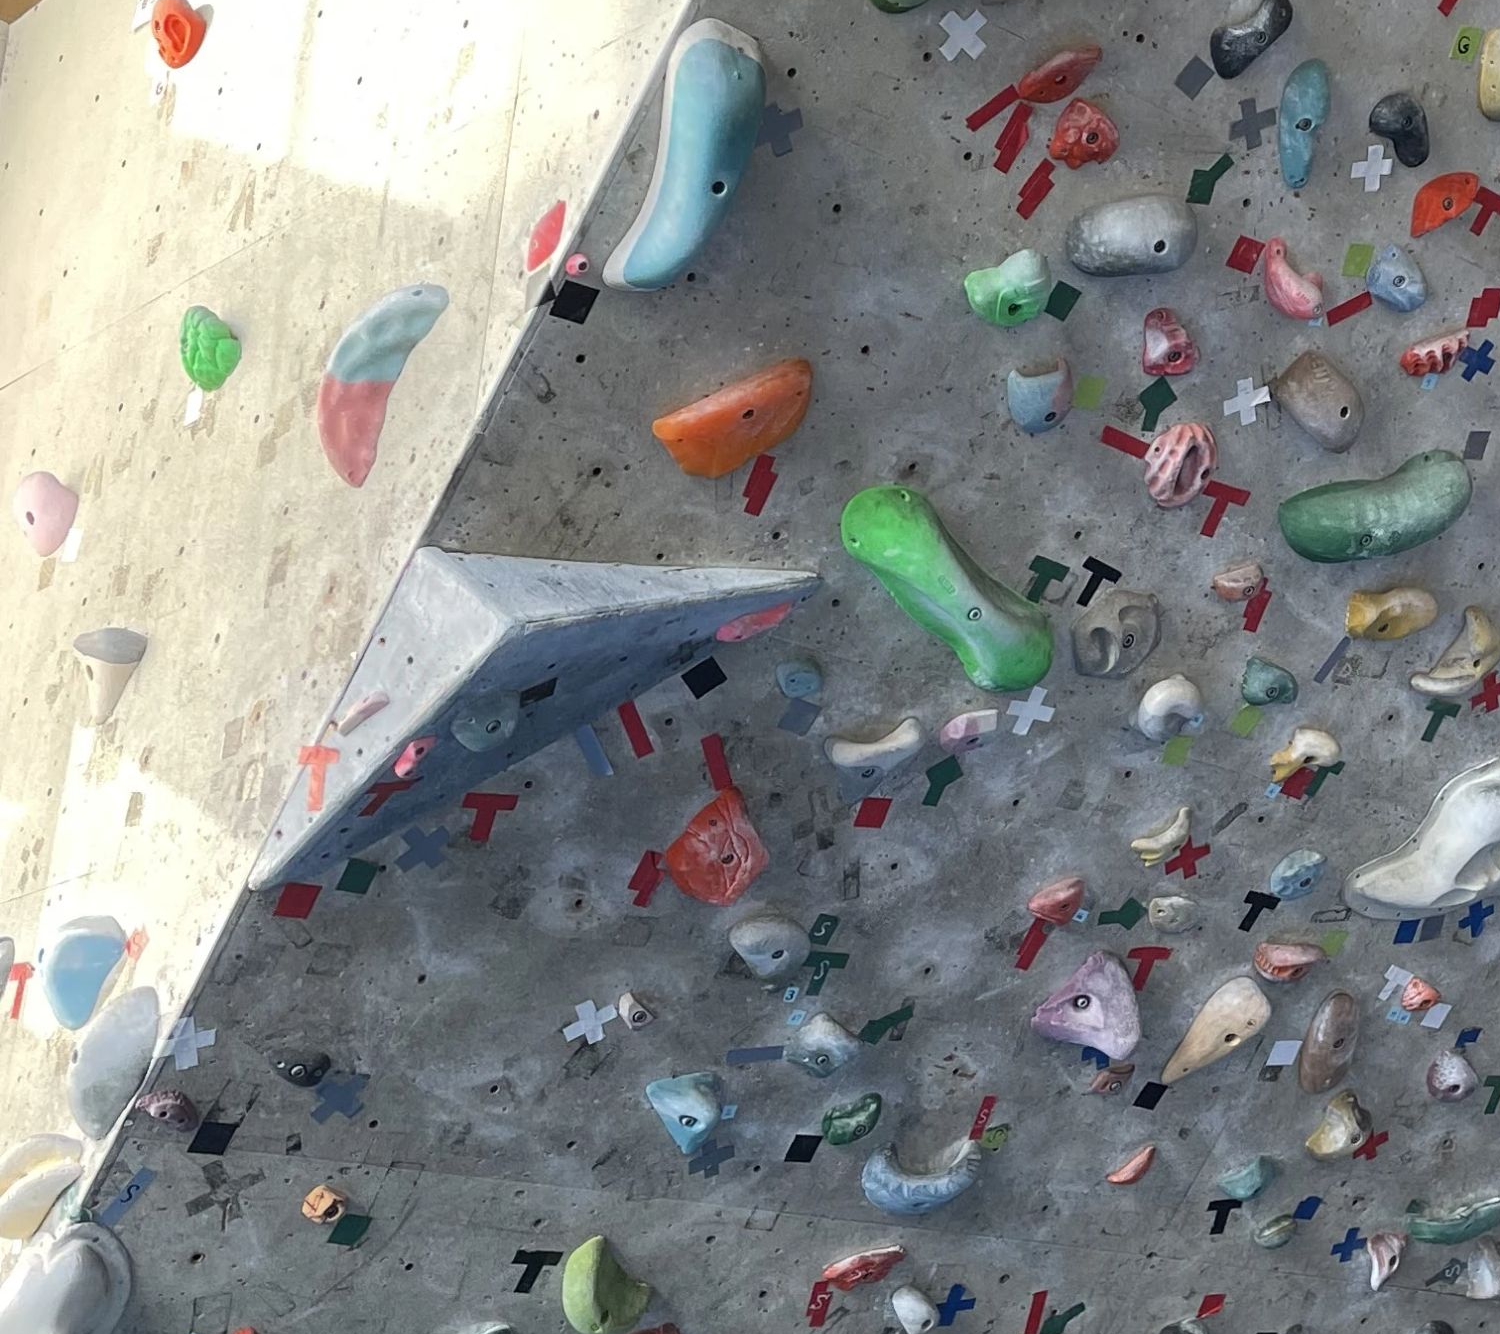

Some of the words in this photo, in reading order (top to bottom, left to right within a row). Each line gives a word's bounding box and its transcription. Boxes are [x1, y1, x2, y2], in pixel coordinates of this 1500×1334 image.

[1457, 35, 1472, 55] G
[814, 921, 831, 937] S
[813, 959, 830, 980] S
[785, 989, 795, 1001] 3
[120, 1184, 140, 1204] S
